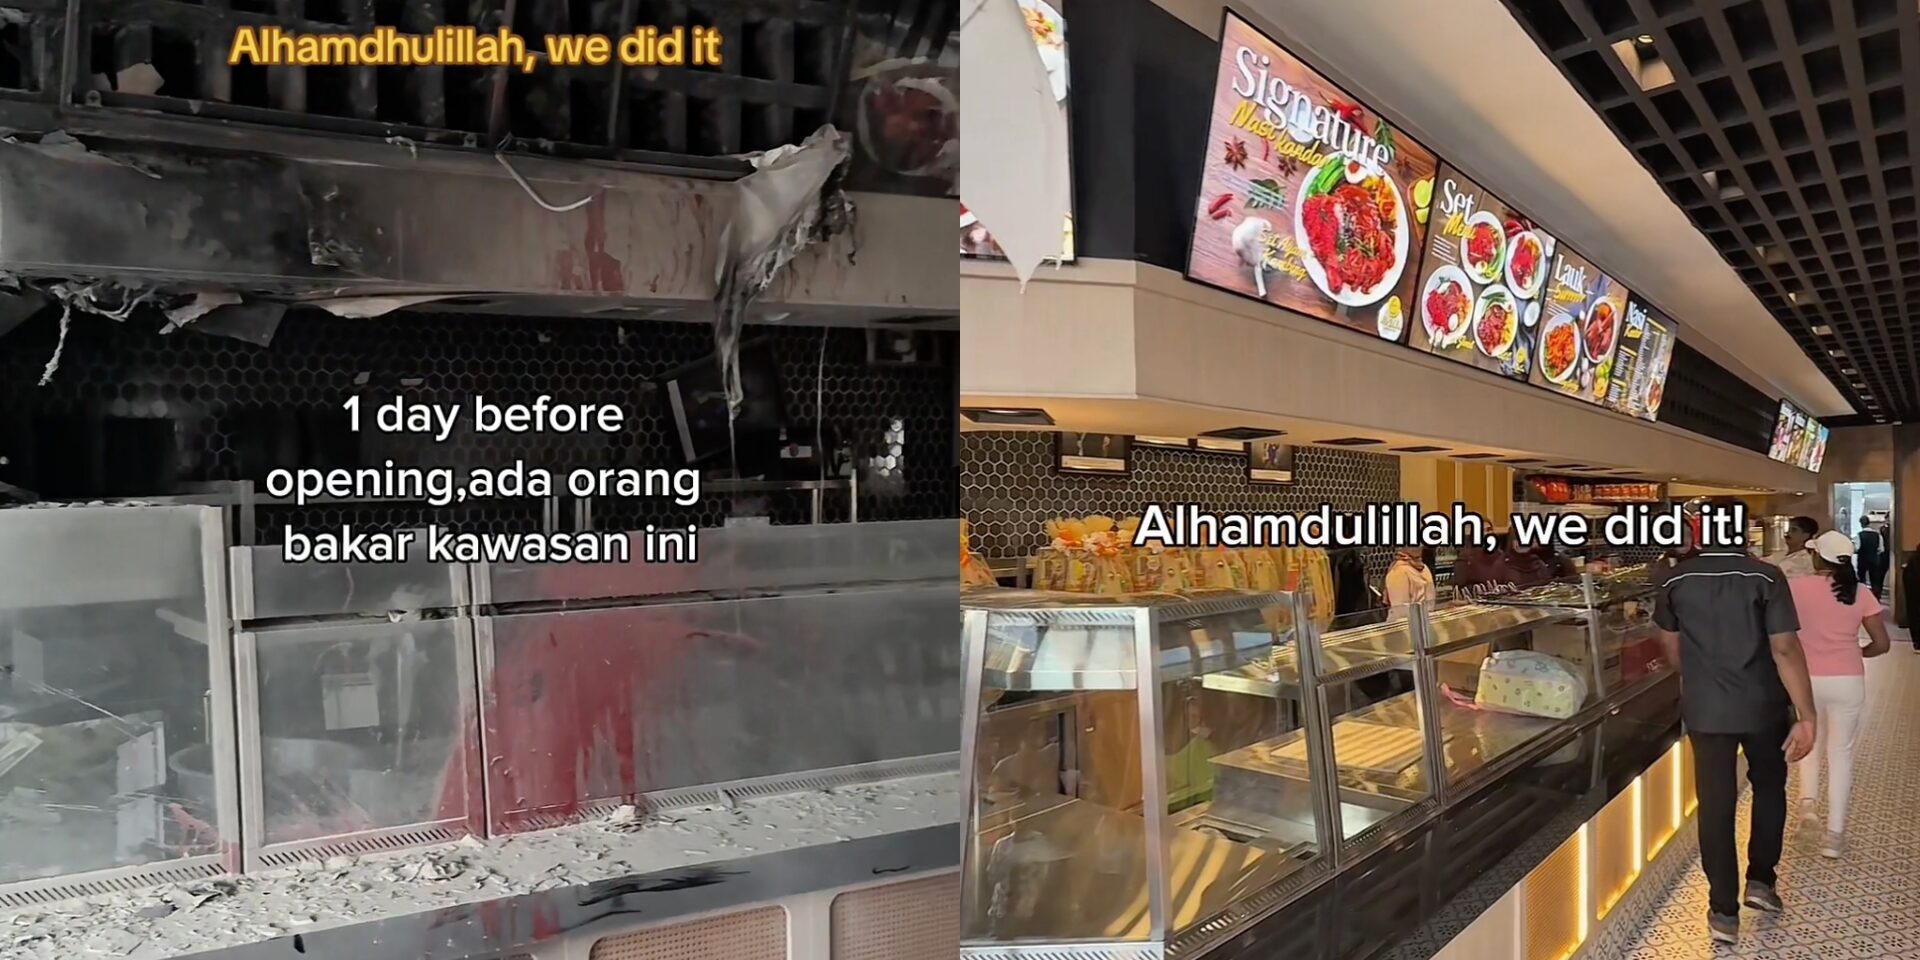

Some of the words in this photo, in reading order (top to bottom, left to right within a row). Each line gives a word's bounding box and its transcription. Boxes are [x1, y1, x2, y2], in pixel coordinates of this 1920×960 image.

[1232, 46, 1391, 176] Signature
[1440, 179, 1475, 225] Set
[1554, 253, 1587, 295] Lauk
